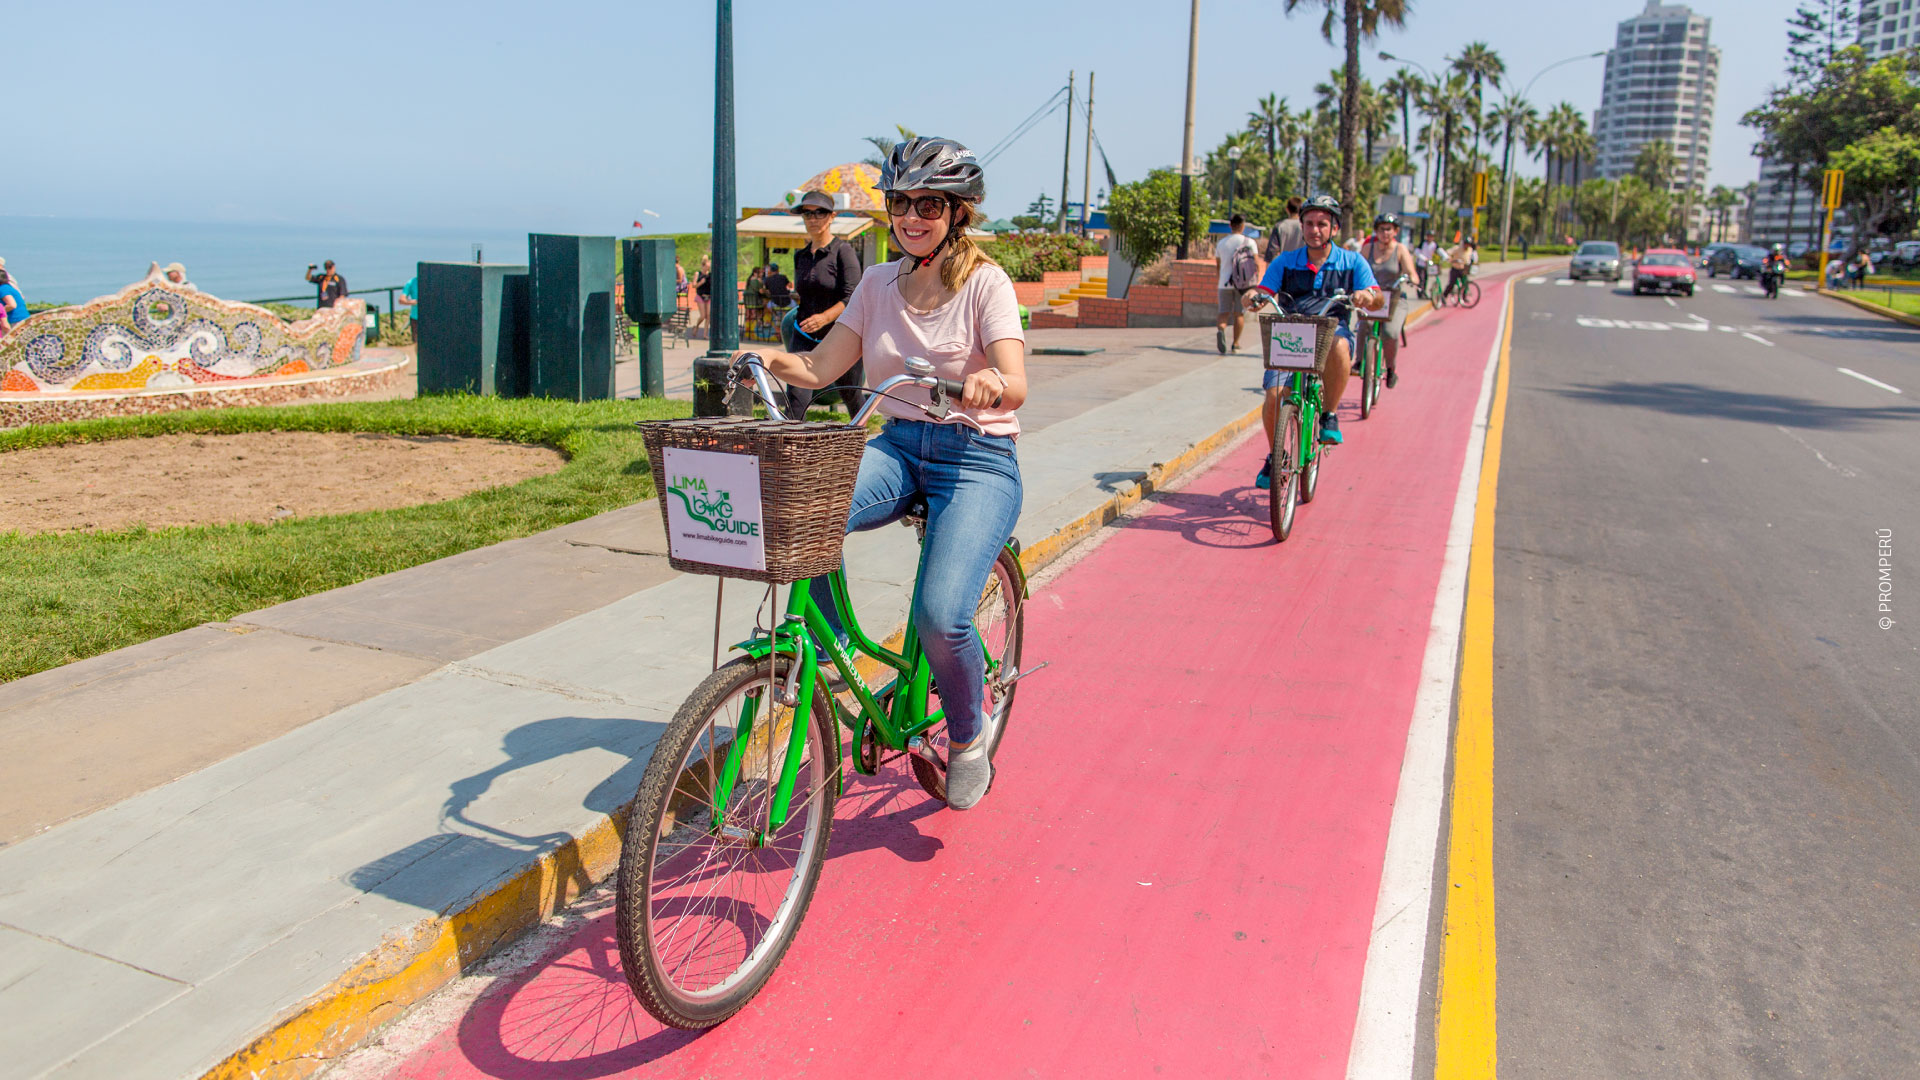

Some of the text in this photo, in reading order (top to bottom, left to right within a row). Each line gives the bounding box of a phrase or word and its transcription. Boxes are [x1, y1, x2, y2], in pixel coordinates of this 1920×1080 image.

[673, 475, 708, 492] LIMA
[715, 518, 760, 537] GUIDE
[683, 532, 748, 546] www.limabikeguide.com
